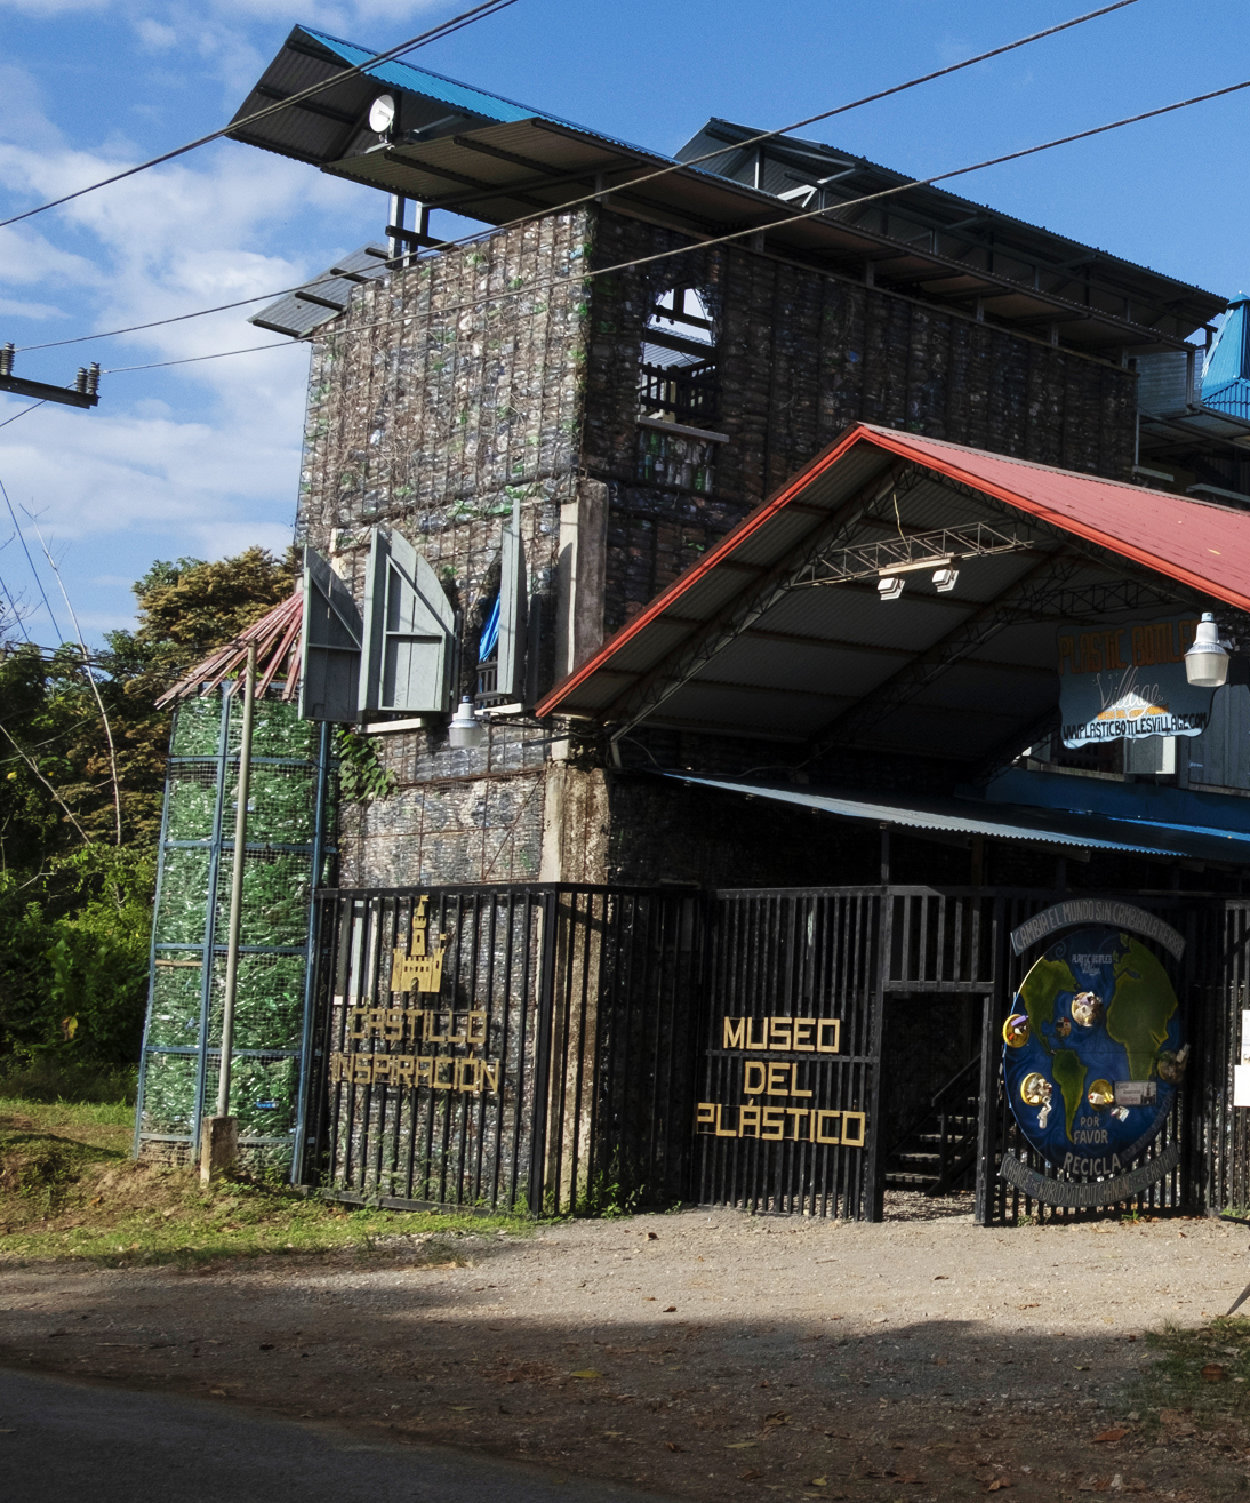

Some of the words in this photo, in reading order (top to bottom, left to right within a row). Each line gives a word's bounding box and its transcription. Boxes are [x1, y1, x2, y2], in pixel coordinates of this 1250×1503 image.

[1131, 618, 1200, 667] BOTTLE
[1048, 907, 1064, 929] EL
[1063, 901, 1094, 922] MUNDO
[350, 1006, 488, 1043] CASTILLO
[723, 1016, 841, 1053] MUSEO
[744, 1061, 812, 1097] DEL
[697, 1098, 866, 1147] PLÁSTICO
[1073, 1129, 1109, 1145] FAVOR
[1080, 1115, 1100, 1128] POR
